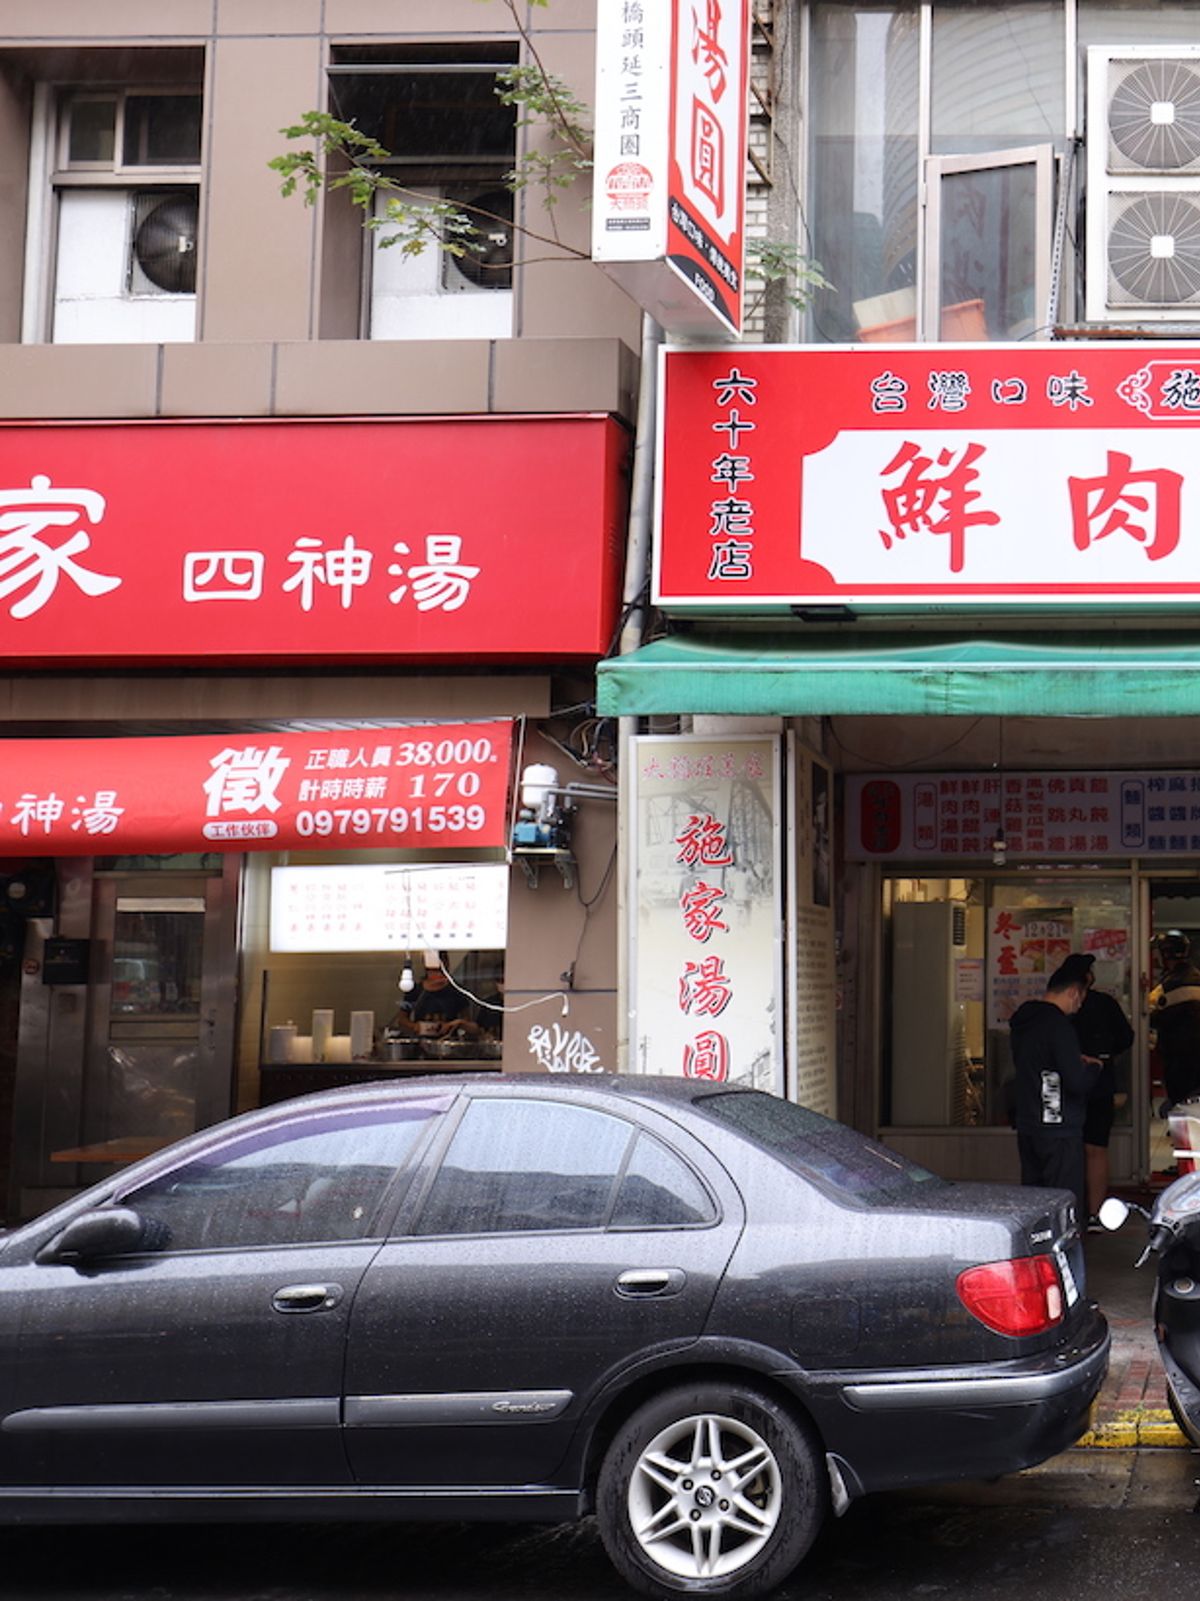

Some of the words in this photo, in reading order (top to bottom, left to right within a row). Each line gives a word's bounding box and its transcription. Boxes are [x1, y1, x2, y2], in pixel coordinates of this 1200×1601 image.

[872, 371, 1094, 413] 台灣口味
[708, 367, 757, 583] 六十年老店
[182, 534, 481, 611] 四神湯
[203, 746, 291, 816] 徵
[305, 749, 390, 770] 正職人員
[299, 777, 387, 802] 計時時薪
[408, 771, 481, 799] 170
[0, 790, 125, 836] 神湯
[296, 805, 486, 837] 0979791539
[675, 814, 734, 1083] 施家湯圓
